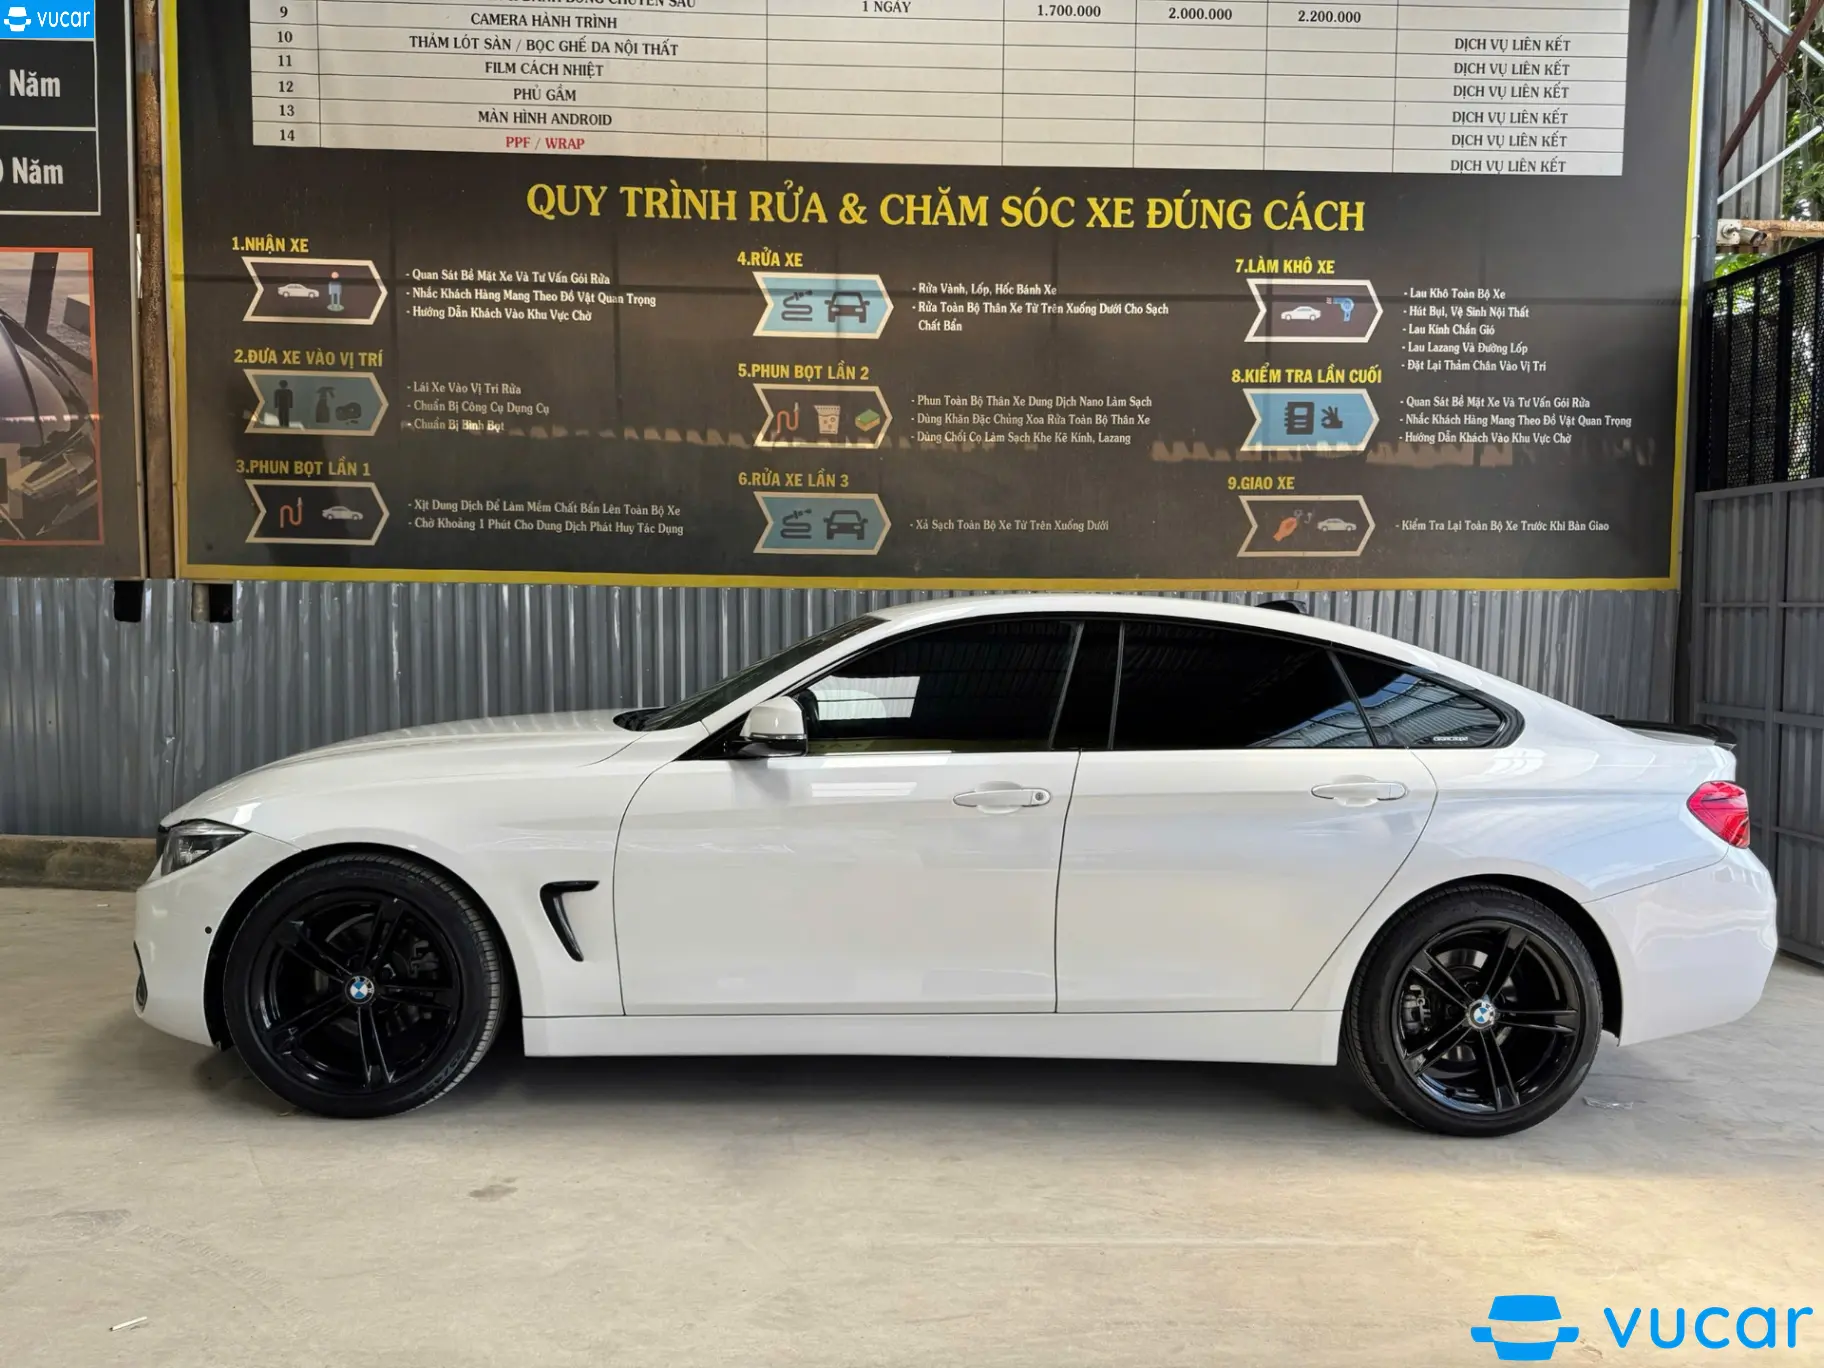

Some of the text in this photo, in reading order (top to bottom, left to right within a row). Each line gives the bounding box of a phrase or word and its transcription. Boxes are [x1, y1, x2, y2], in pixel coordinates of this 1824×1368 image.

[280, 6, 288, 18] 9
[862, 0, 868, 12] 1
[1038, 5, 1101, 17] 1.700.000
[1168, 7, 1232, 20] 2.000.000
[471, 12, 617, 29] CAMERA HÀNH TRÌNH
[1298, 10, 1361, 23] 2.200.000
[278, 31, 293, 43] 10
[409, 33, 449, 48] THẢM
[454, 34, 480, 49] LÓT
[484, 35, 511, 50] SÀN
[526, 39, 555, 53] BỌC
[558, 36, 587, 53] GHẾ
[592, 41, 610, 53] DA
[614, 39, 638, 56] NỘI
[642, 39, 679, 56] THẤT
[1455, 35, 1571, 53] DỊCH VỤ LIÊN KẾT
[278, 55, 292, 67] 11
[485, 60, 604, 78] FILM CÁCH NHIỆT
[1454, 60, 1570, 77] DỊCH VỤ LIÊN KẾT
[9, 69, 61, 98] Năm
[279, 81, 294, 93] 12
[1454, 83, 1570, 100] DỊCH VỤ LIÊN KẾT
[514, 85, 541, 101] PHỦ
[280, 104, 295, 117] 13
[478, 108, 612, 126] MÀN HÌNH ANDROID
[280, 129, 295, 142] 14
[506, 136, 531, 148] PPF
[545, 138, 585, 150] WRAP
[1452, 131, 1568, 148] DỊCH VỤ LIÊN KẾT
[12, 156, 64, 185] Năm
[527, 180, 1365, 232] QUY TRÌNH RỬA & CHĂM SÓC XE ĐÚNG CÁCH
[232, 234, 309, 254] 1.NHẬN XE
[737, 247, 803, 267] 4.RỬA XE
[1235, 256, 1335, 274] 7.LÀM KHÔ XE
[440, 288, 472, 299] Khách
[474, 289, 501, 303] Hàng
[503, 289, 530, 303] Mang
[532, 290, 558, 302] Theo
[598, 292, 624, 305] Quan
[918, 282, 938, 294] Rửa
[1016, 284, 1042, 295] Bánh
[1044, 284, 1057, 295] Xe
[1410, 287, 1427, 298] Lau
[1430, 288, 1449, 299] Khô
[1493, 288, 1506, 300] Xe
[234, 348, 383, 369] 2.ĐƯA XE VÀO VỊ TRÍ
[738, 361, 869, 382] 5.PHUN BỌT LẦN 2
[1231, 363, 1382, 383] 8.KIỂM TRA LẦN CUỐI
[461, 401, 488, 414] Công
[918, 395, 941, 406] Phun
[986, 395, 1010, 406] Thân
[1013, 396, 1026, 407] Xe
[1028, 396, 1053, 409] Dung
[1056, 396, 1077, 408] Dịch
[1080, 396, 1104, 407] Nano
[1106, 396, 1127, 407] Làm
[1129, 396, 1152, 409] Sạch
[236, 458, 371, 477] 3.PHUN BỌT LẦN 1
[738, 468, 849, 488] 6.RỬA XE LẦN 3
[1228, 476, 1295, 490] 9.GIAO XE
[480, 518, 484, 529] 1
[488, 518, 511, 530] Phút
[514, 519, 534, 530] Cho
[536, 520, 562, 533] Dung
[565, 520, 587, 533] Dịch
[615, 522, 635, 535] Huy
[637, 522, 655, 534] Tác
[1429, 520, 1445, 531] Tra
[1505, 520, 1518, 531] Xe
[1588, 520, 1610, 531] Giao
